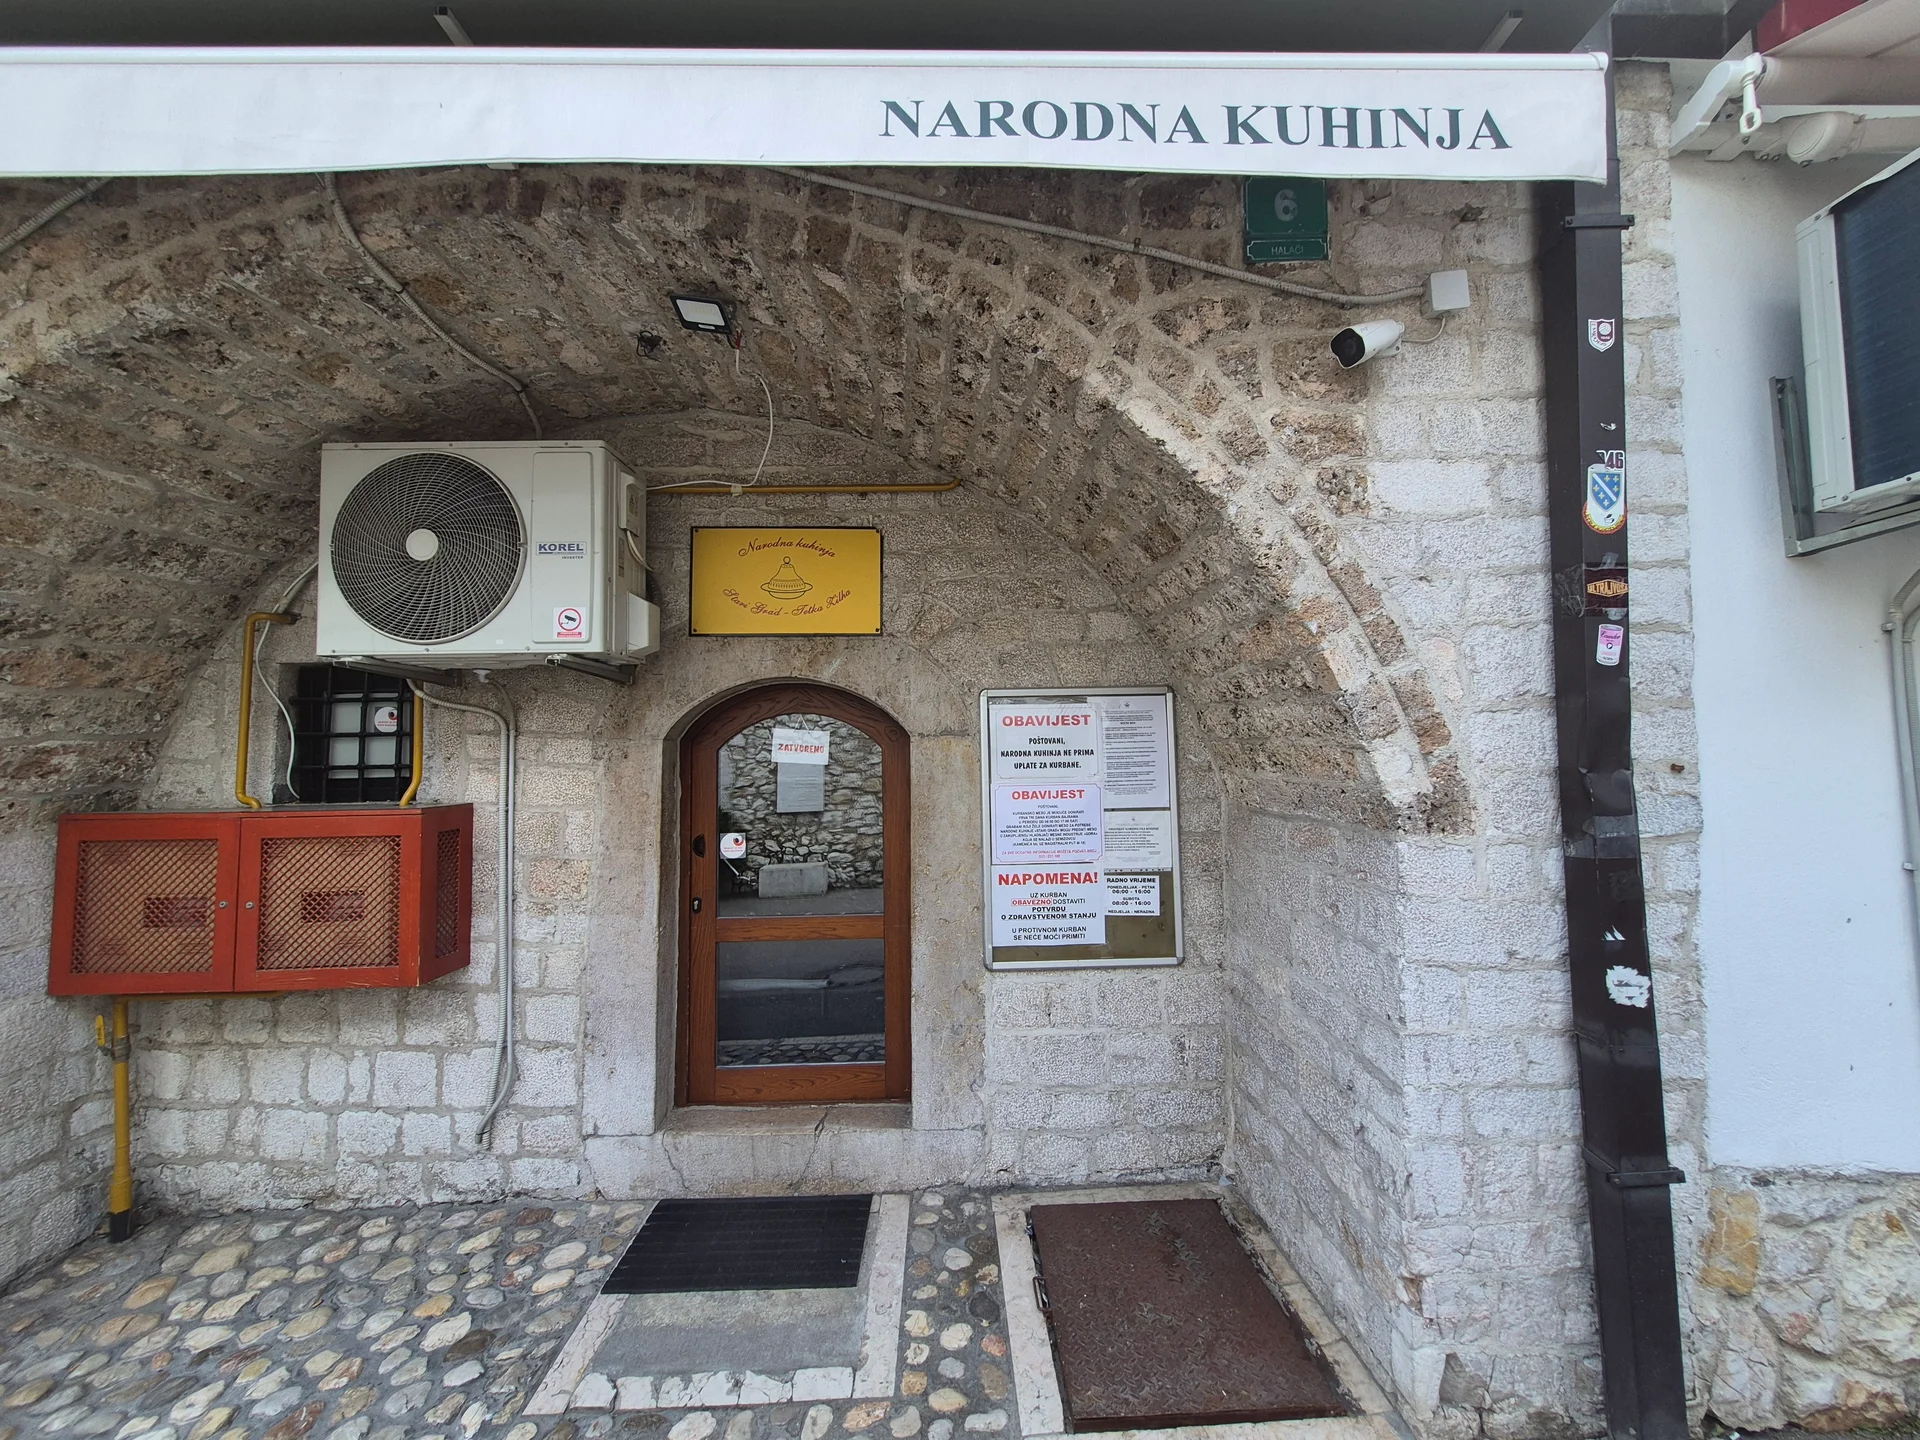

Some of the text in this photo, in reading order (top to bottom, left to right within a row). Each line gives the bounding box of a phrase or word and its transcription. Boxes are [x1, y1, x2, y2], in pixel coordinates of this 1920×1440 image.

[878, 99, 1513, 150] NARODNA KUHINJA
[1274, 188, 1298, 222] 6
[538, 543, 584, 552] KOREL
[738, 536, 836, 558] Narodna kuhinja
[722, 588, 751, 609] Stari
[750, 601, 781, 616] Grad
[791, 603, 823, 617] Tetka
[1002, 714, 1091, 727] OBAVIJEST
[1028, 735, 1066, 745] POŠTOVANI,
[778, 743, 825, 754] ZATVORENO
[1000, 749, 1032, 758] NARODNA
[1033, 749, 1061, 757] KUHINJA
[1013, 762, 1037, 770] UPLATE
[1049, 761, 1082, 769] KURBANE.
[1012, 789, 1085, 800] OBAVIJEST
[998, 871, 1098, 886] NAPOMENA!
[1023, 933, 1042, 941] NEĆE
